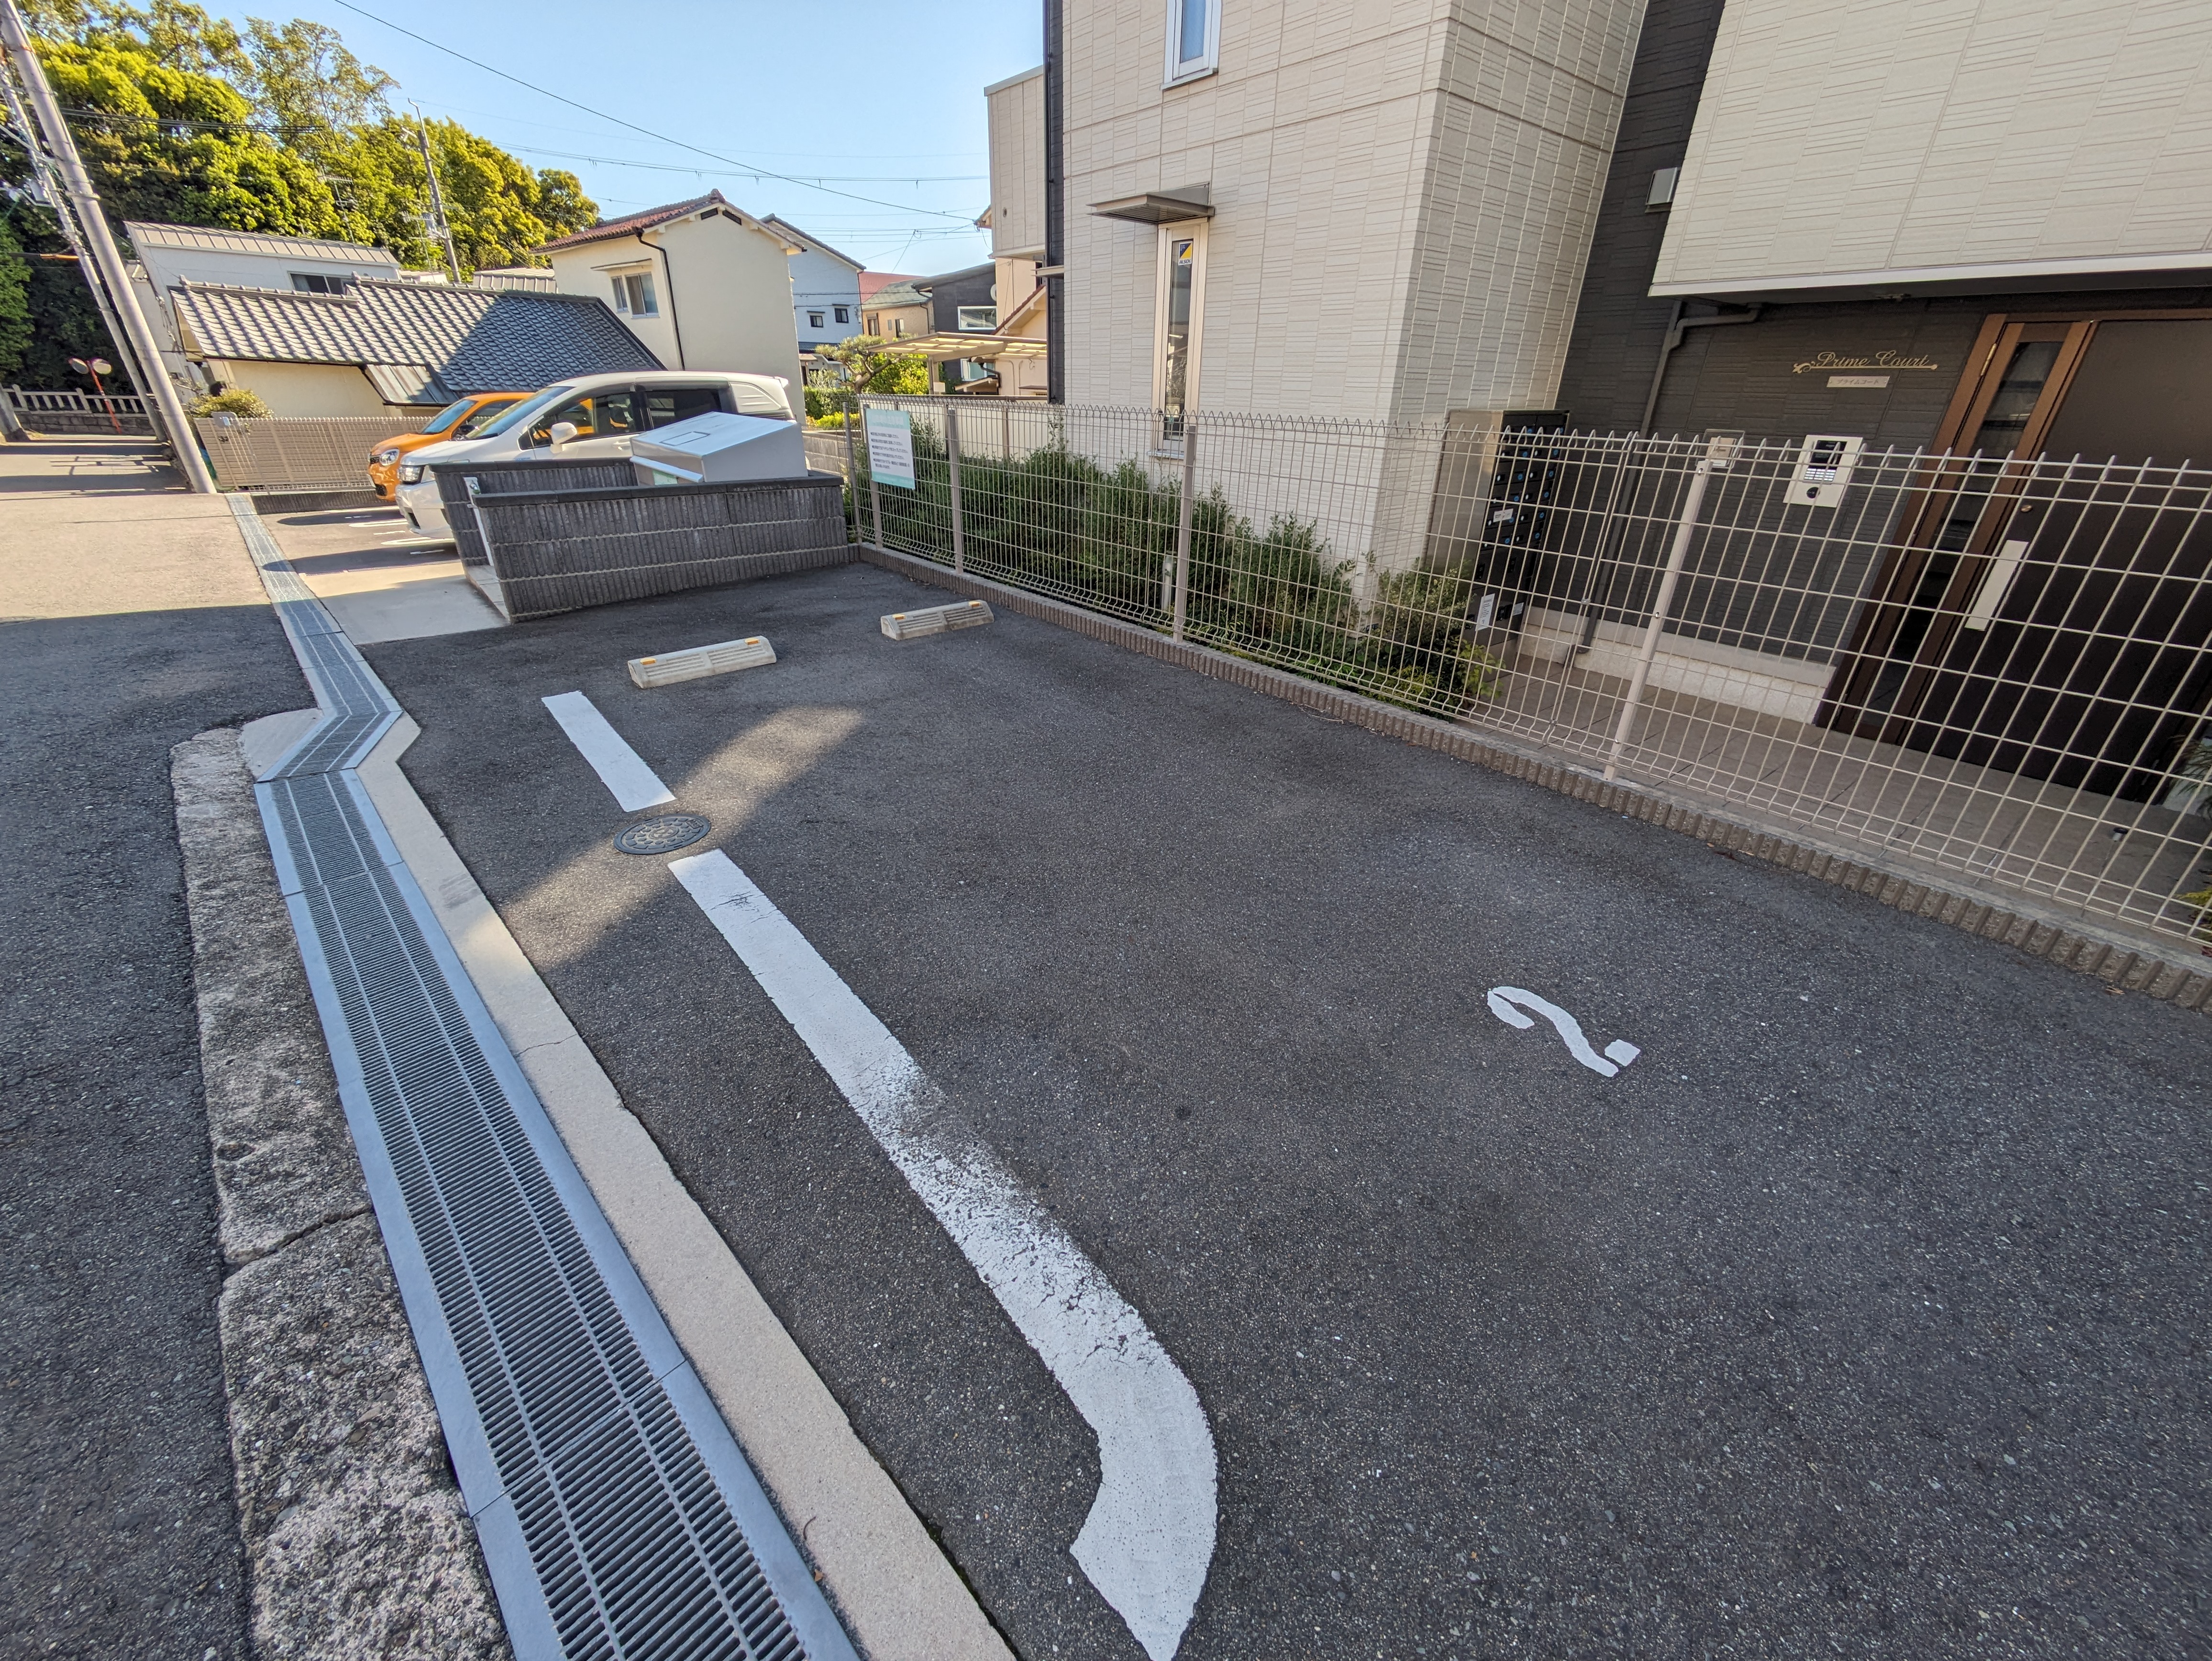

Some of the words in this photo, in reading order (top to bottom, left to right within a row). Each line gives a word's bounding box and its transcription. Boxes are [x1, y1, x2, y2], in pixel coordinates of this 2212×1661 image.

[1817, 352, 1869, 366] Prime
[1876, 350, 1930, 366] Court
[1487, 986, 1641, 1077] 2
